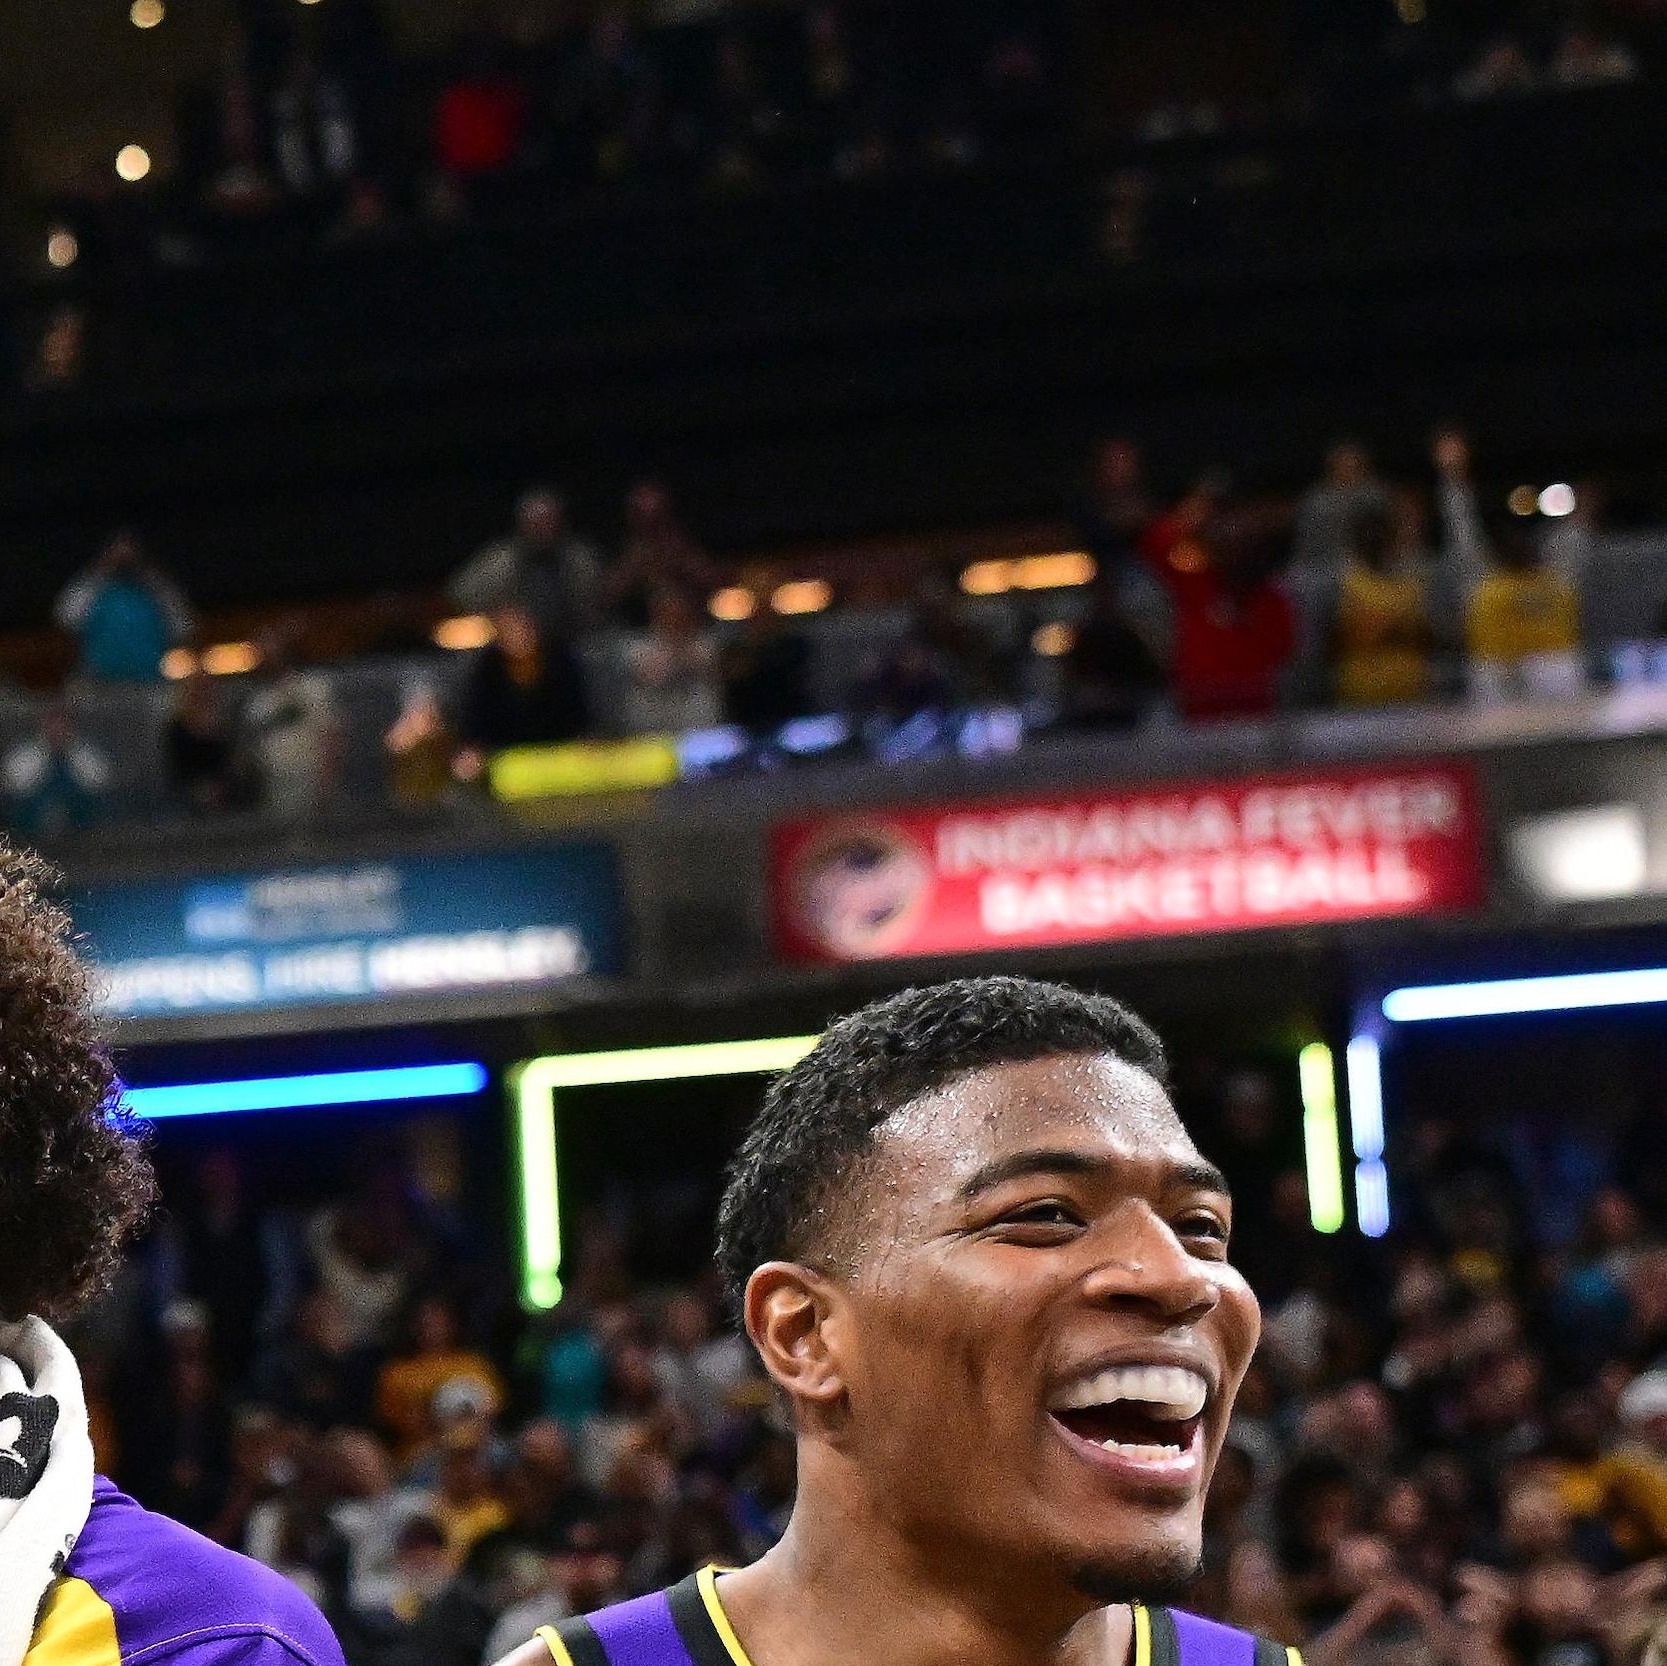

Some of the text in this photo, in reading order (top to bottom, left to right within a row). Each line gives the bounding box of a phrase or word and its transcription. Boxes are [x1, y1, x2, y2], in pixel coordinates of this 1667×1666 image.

[935, 776, 1462, 874] INDIANA FEVER
[979, 850, 1431, 935] BASKETBALL
